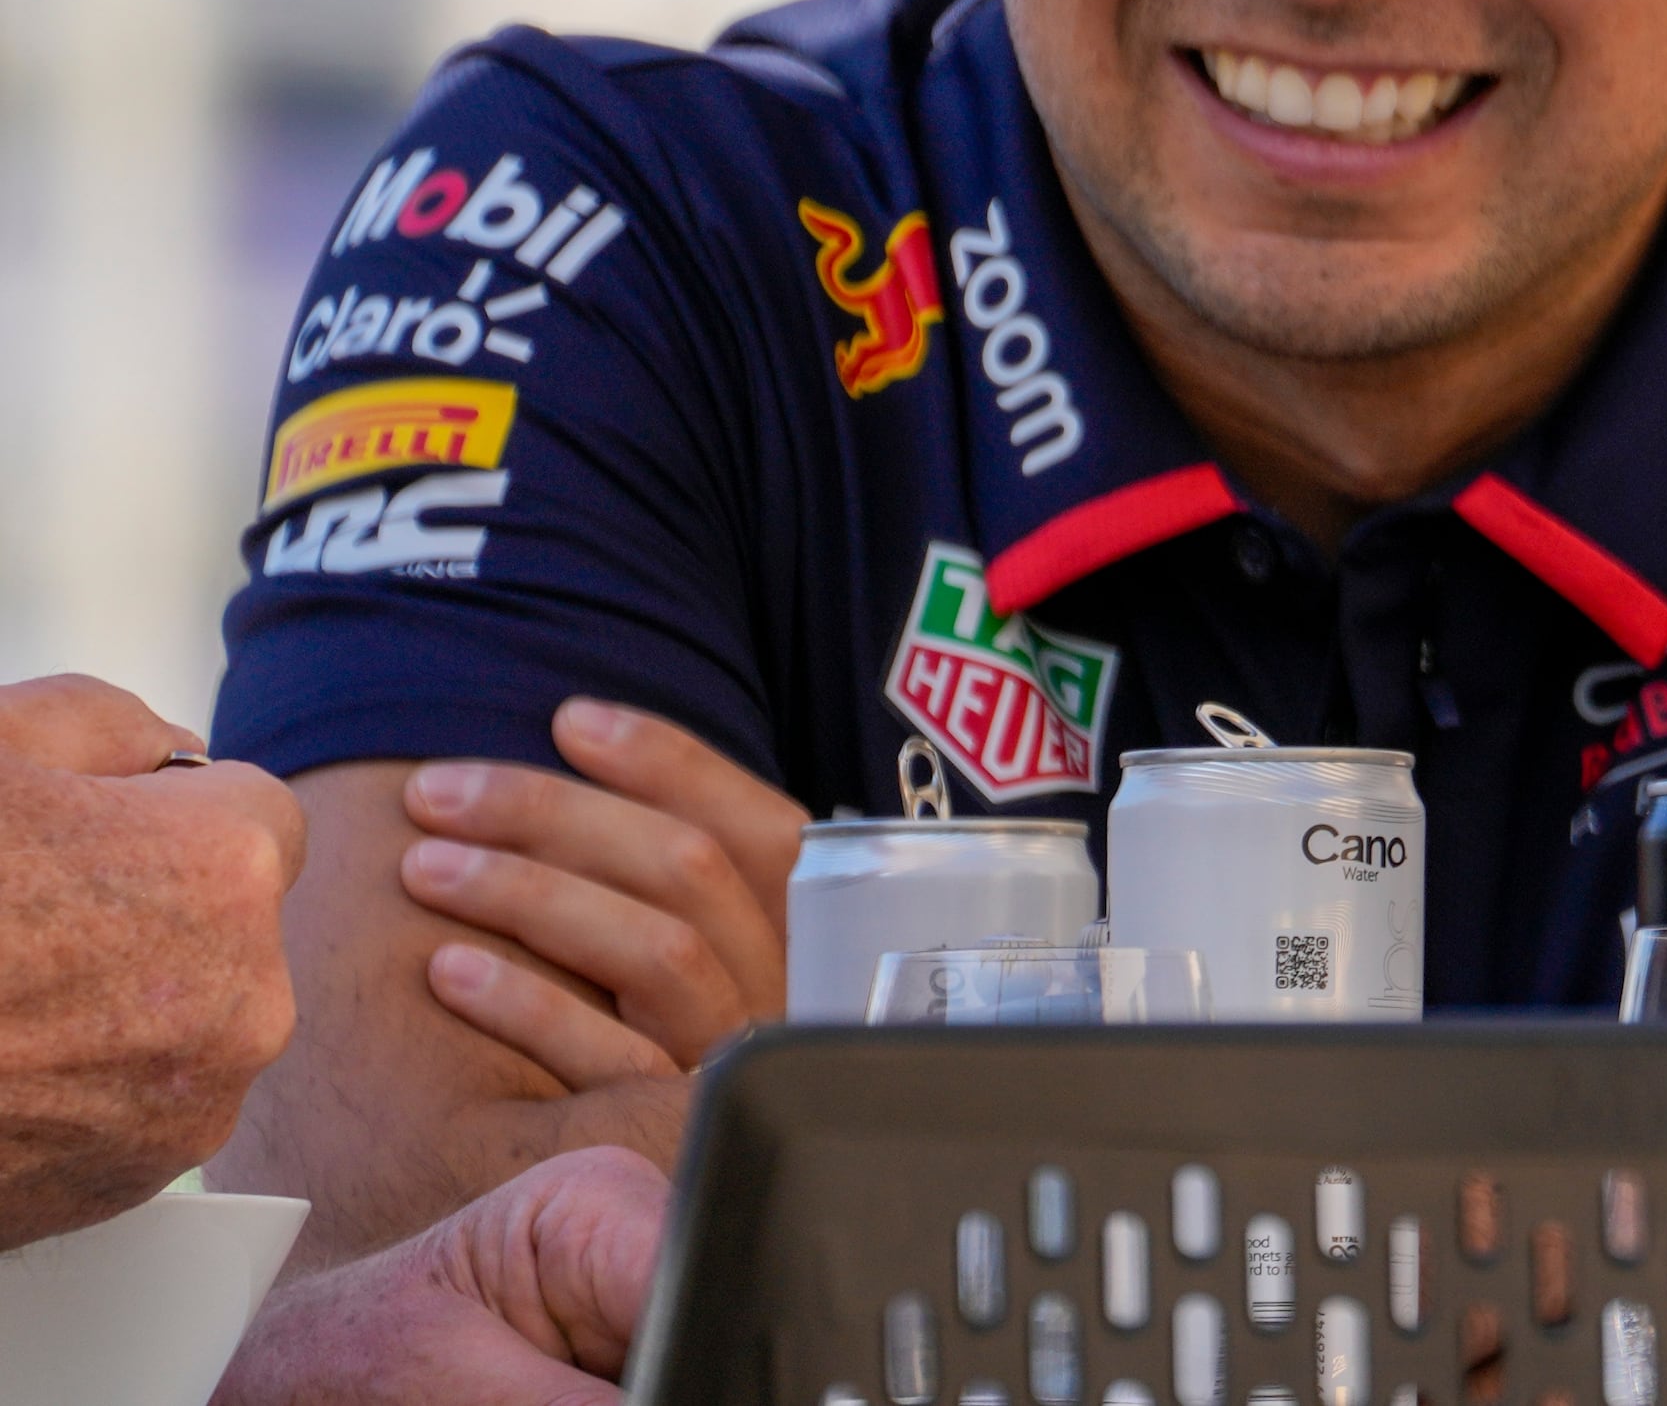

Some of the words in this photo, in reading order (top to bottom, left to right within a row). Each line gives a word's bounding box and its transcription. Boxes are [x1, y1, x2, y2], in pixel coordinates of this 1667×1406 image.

[331, 146, 626, 285] Mobil
[951, 197, 1084, 477] zoom
[276, 407, 478, 494] PIRELLI
[906, 649, 1086, 783] HEUER
[1301, 824, 1407, 869] Cano
[1342, 865, 1380, 884] Water
